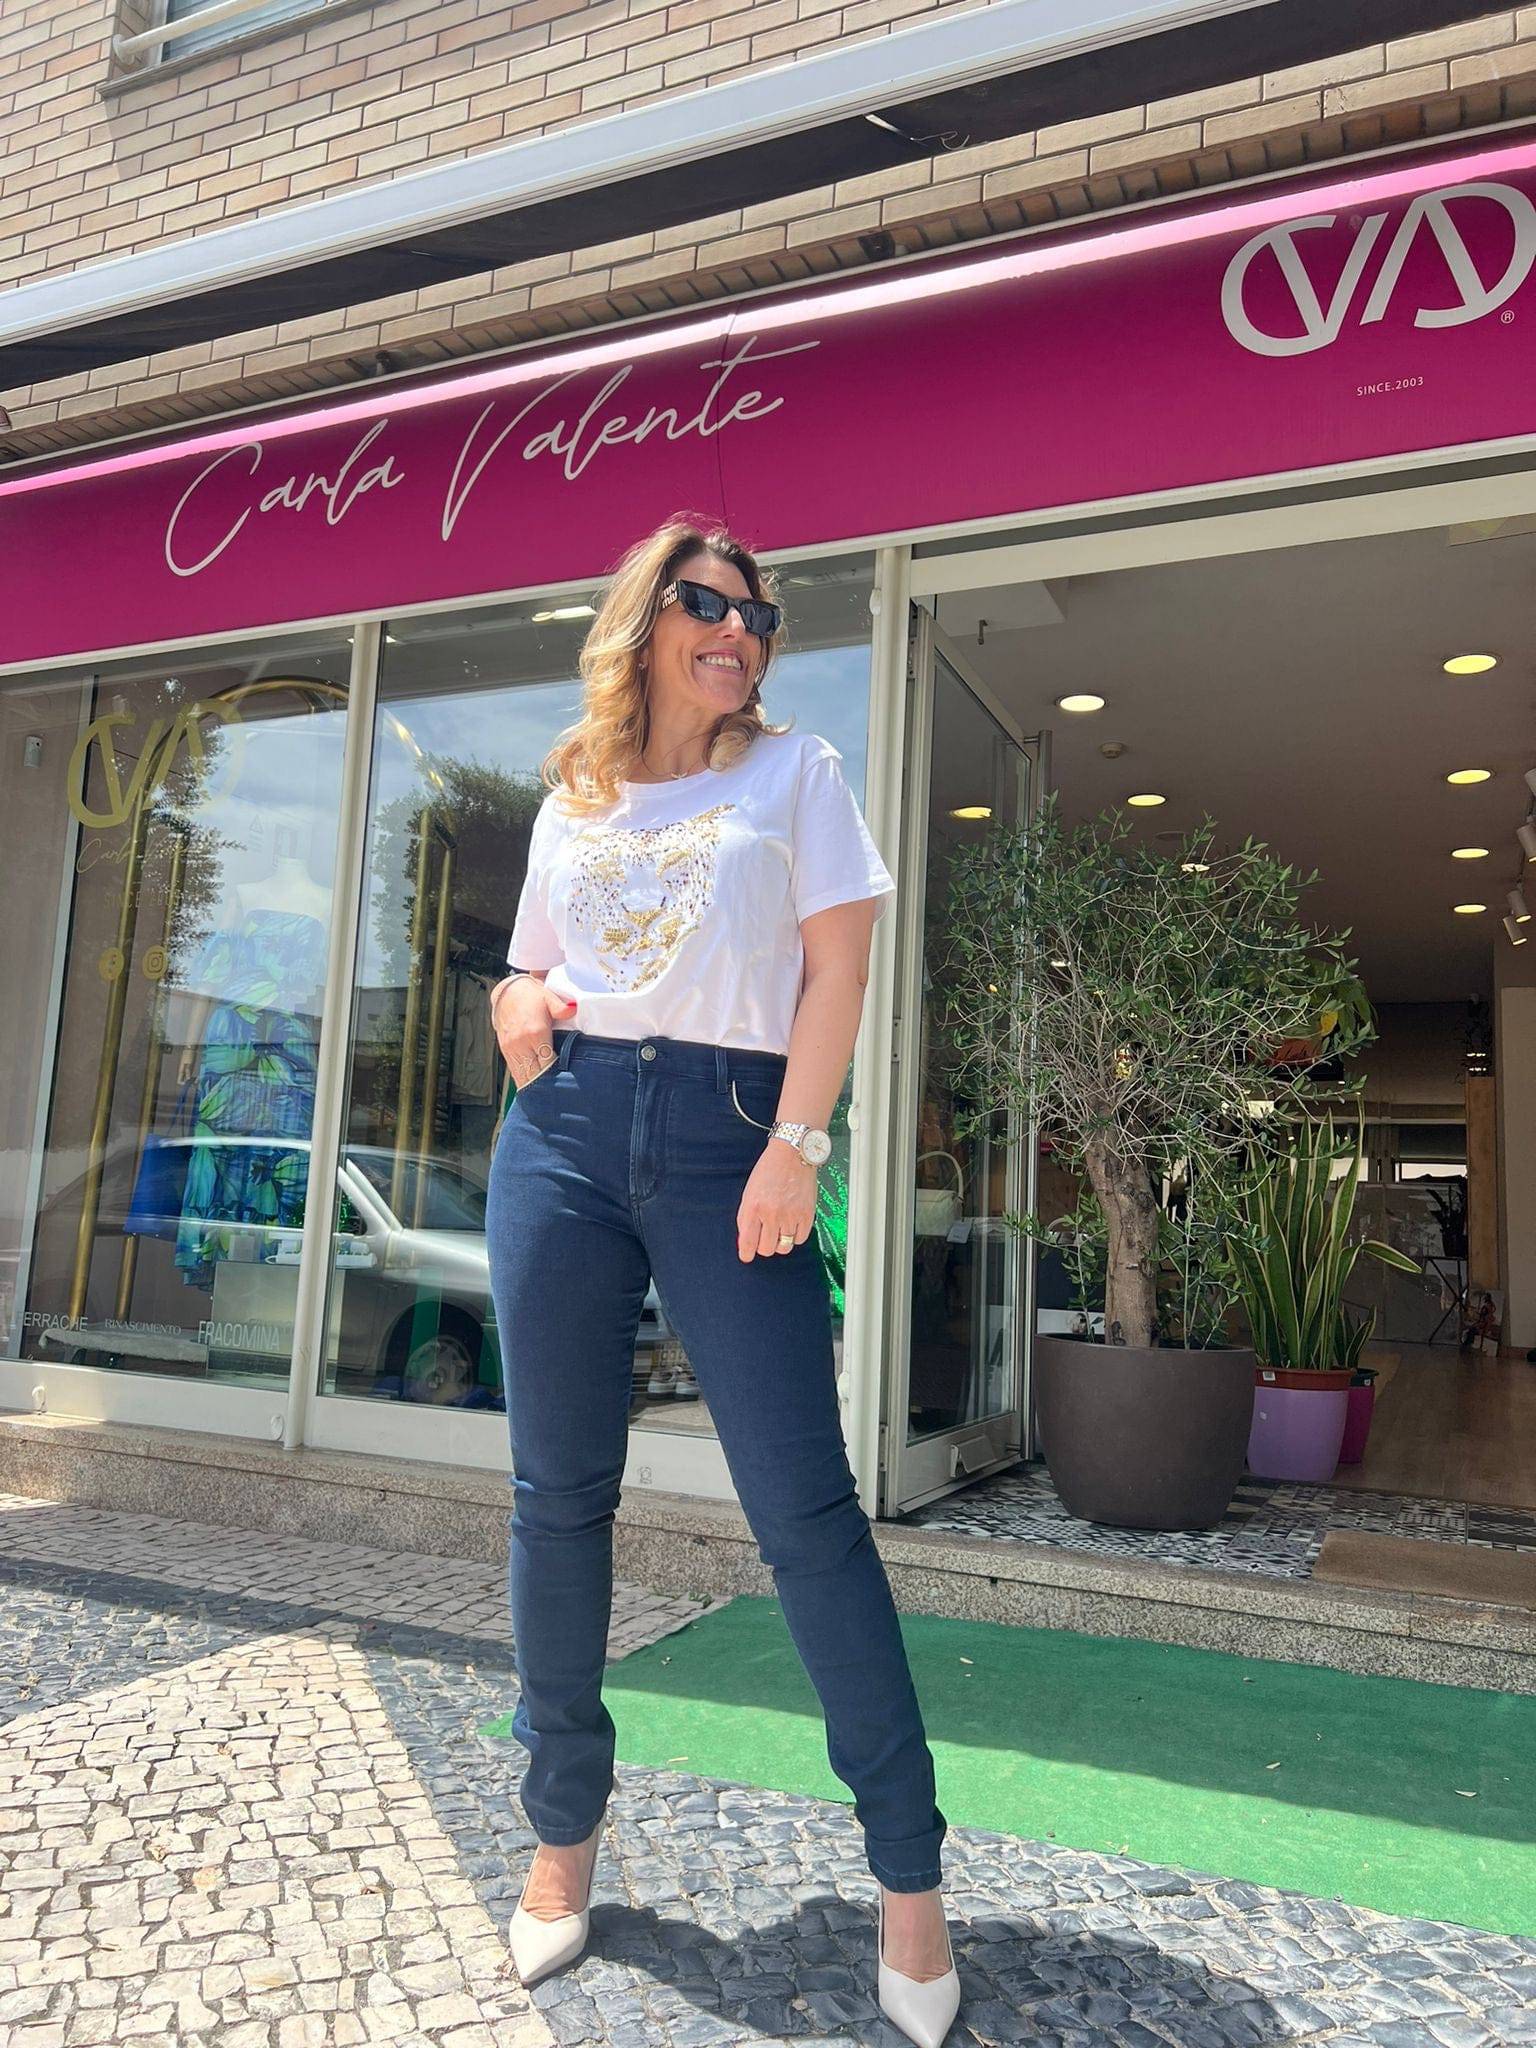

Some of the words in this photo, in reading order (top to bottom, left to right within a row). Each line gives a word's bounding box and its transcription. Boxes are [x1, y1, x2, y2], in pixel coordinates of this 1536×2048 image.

[1356, 376, 1425, 396] SINCE.2003
[165, 420, 406, 577] Carla
[441, 336, 820, 541] Valente
[197, 1320, 281, 1351] FRACOMINA
